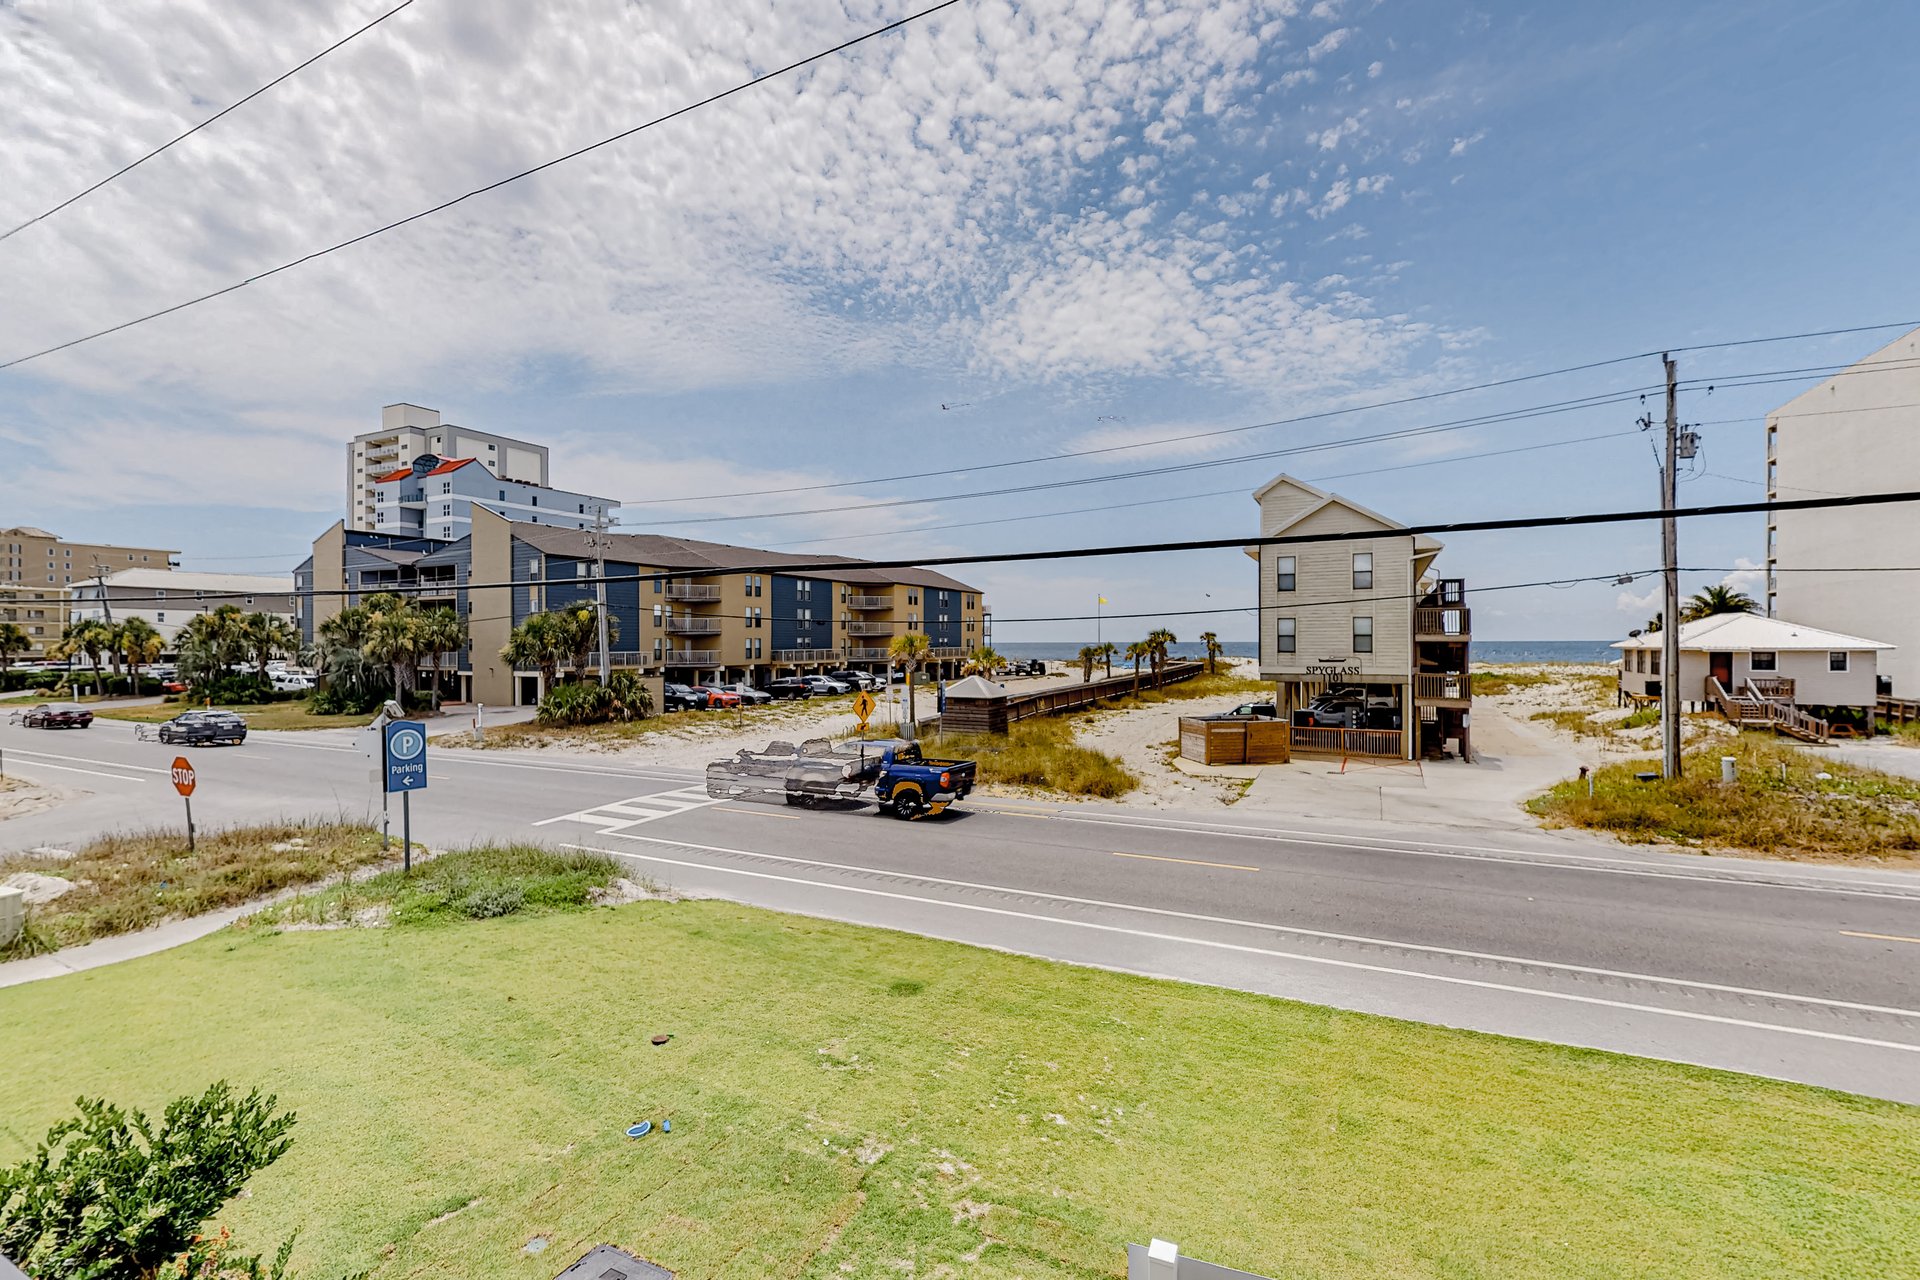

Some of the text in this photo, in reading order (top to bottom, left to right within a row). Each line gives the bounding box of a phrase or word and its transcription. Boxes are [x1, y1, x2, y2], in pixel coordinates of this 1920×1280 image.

[1306, 666, 1360, 675] SPYGLASS
[402, 736, 414, 754] P
[391, 763, 423, 775] Parking
[172, 768, 194, 785] STOP
